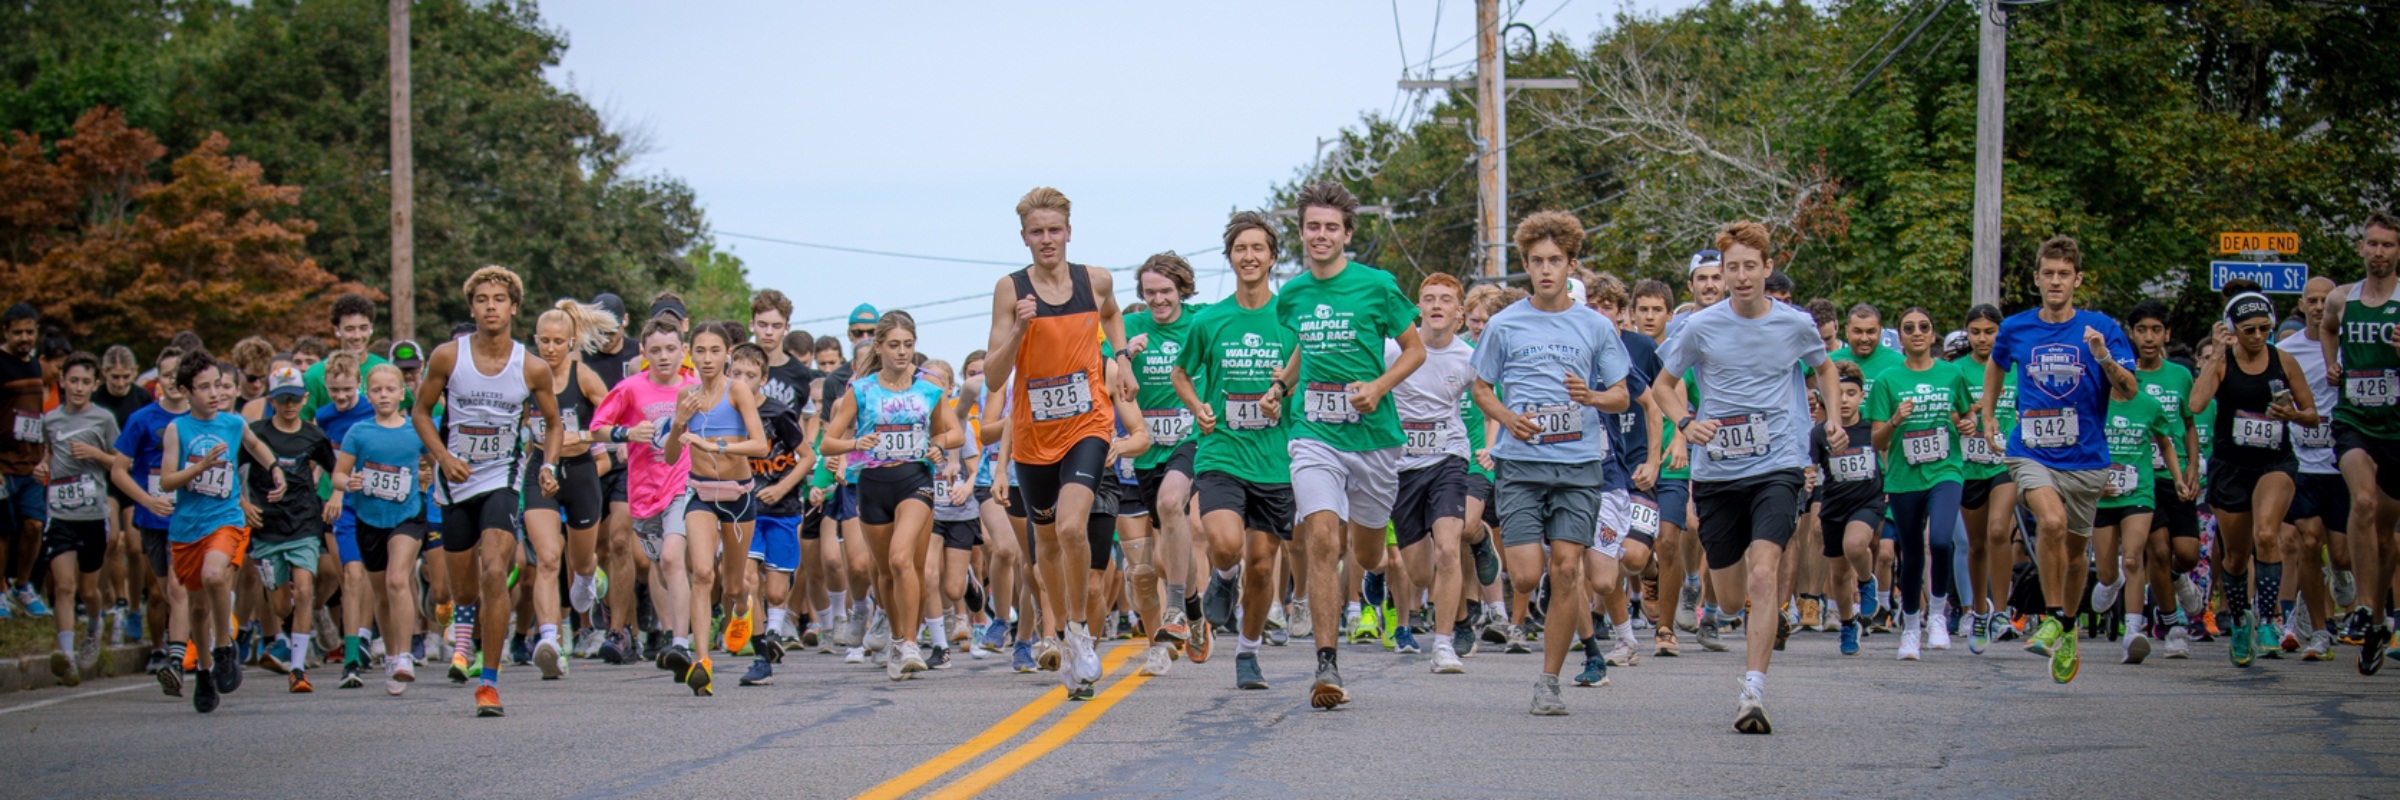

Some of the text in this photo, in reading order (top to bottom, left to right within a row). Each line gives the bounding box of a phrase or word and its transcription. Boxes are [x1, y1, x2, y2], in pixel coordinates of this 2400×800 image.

[2223, 236, 2295, 251] DEAD END
[2283, 267, 2299, 289] St
[1300, 319, 1349, 332] WALPOLE
[1327, 330, 1357, 341] RACE
[1225, 348, 1279, 358] WALPOLE
[1548, 344, 1581, 356] STATE
[1142, 365, 1172, 374] ROAD
[1221, 359, 1284, 368] ROAD RACE
[471, 390, 504, 399] LANCERS
[2356, 379, 2387, 396] 426
[1042, 385, 1078, 408] 325
[1316, 393, 1347, 412] 751
[1238, 403, 1267, 419] 41
[1152, 418, 1182, 435] 402
[1537, 412, 1571, 432] 303
[2034, 418, 2066, 437] 642
[2244, 420, 2273, 439] 648
[469, 436, 500, 452] 748
[885, 433, 914, 450] 301
[1407, 431, 1436, 448] 502
[1719, 425, 1755, 448] 304
[1912, 436, 1941, 455] 895
[1968, 438, 1991, 455] 88
[1840, 456, 1867, 473] 662
[371, 472, 400, 491] 355
[2108, 471, 2126, 488] 25
[58, 485, 85, 500] 685
[1631, 505, 1658, 528] 603
